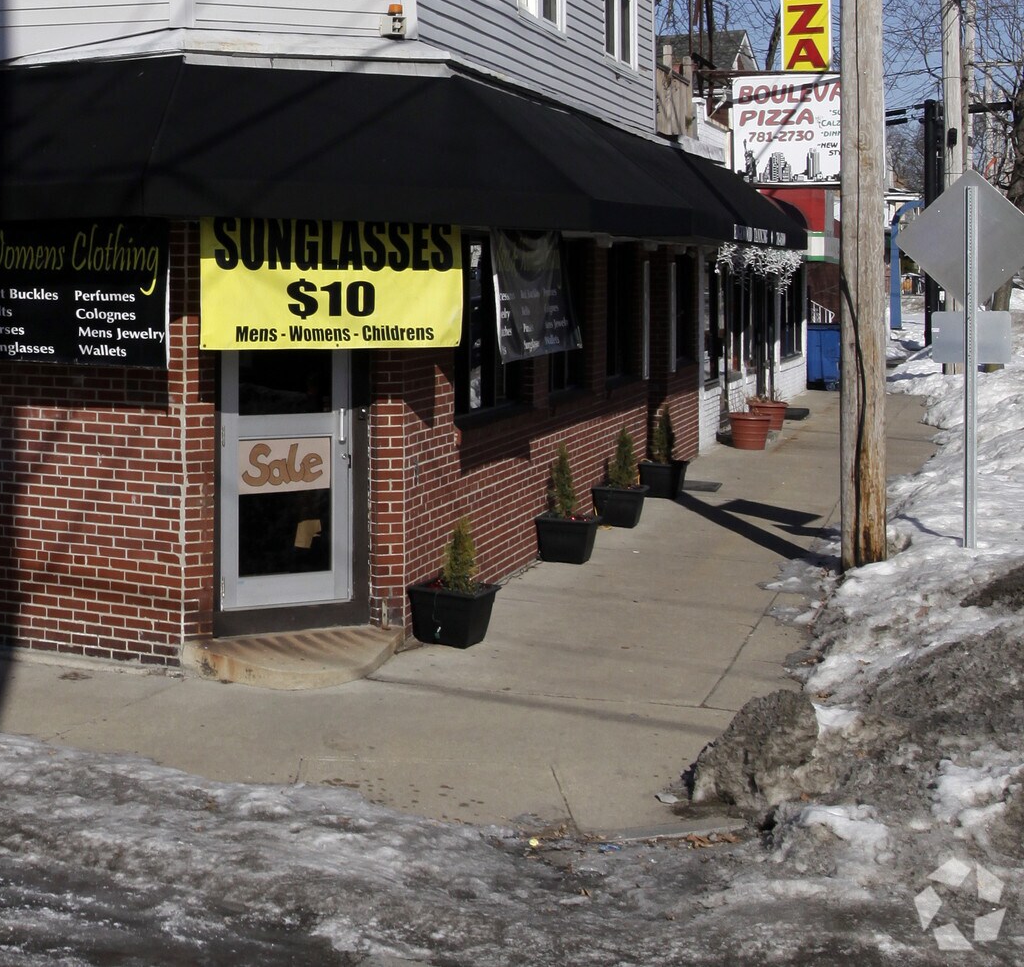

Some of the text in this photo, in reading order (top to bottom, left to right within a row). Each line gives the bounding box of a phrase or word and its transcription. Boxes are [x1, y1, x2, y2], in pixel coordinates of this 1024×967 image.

[738, 82, 841, 105] BOULEVA
[739, 108, 814, 127] PIZZA
[748, 130, 815, 142] 781-2730
[214, 217, 454, 272] SUNGLASSES
[71, 224, 159, 296] Clothing
[9, 288, 59, 301] Buckles
[74, 290, 135, 303] Perfumes
[286, 278, 376, 320] $10
[75, 308, 136, 323] Colognes
[78, 327, 165, 343] Mens Jewelry
[235, 326, 278, 342] Mens
[289, 326, 351, 342] Womens
[362, 325, 434, 342] Childrens
[79, 344, 127, 357] Wallets
[241, 443, 323, 487] Sale
